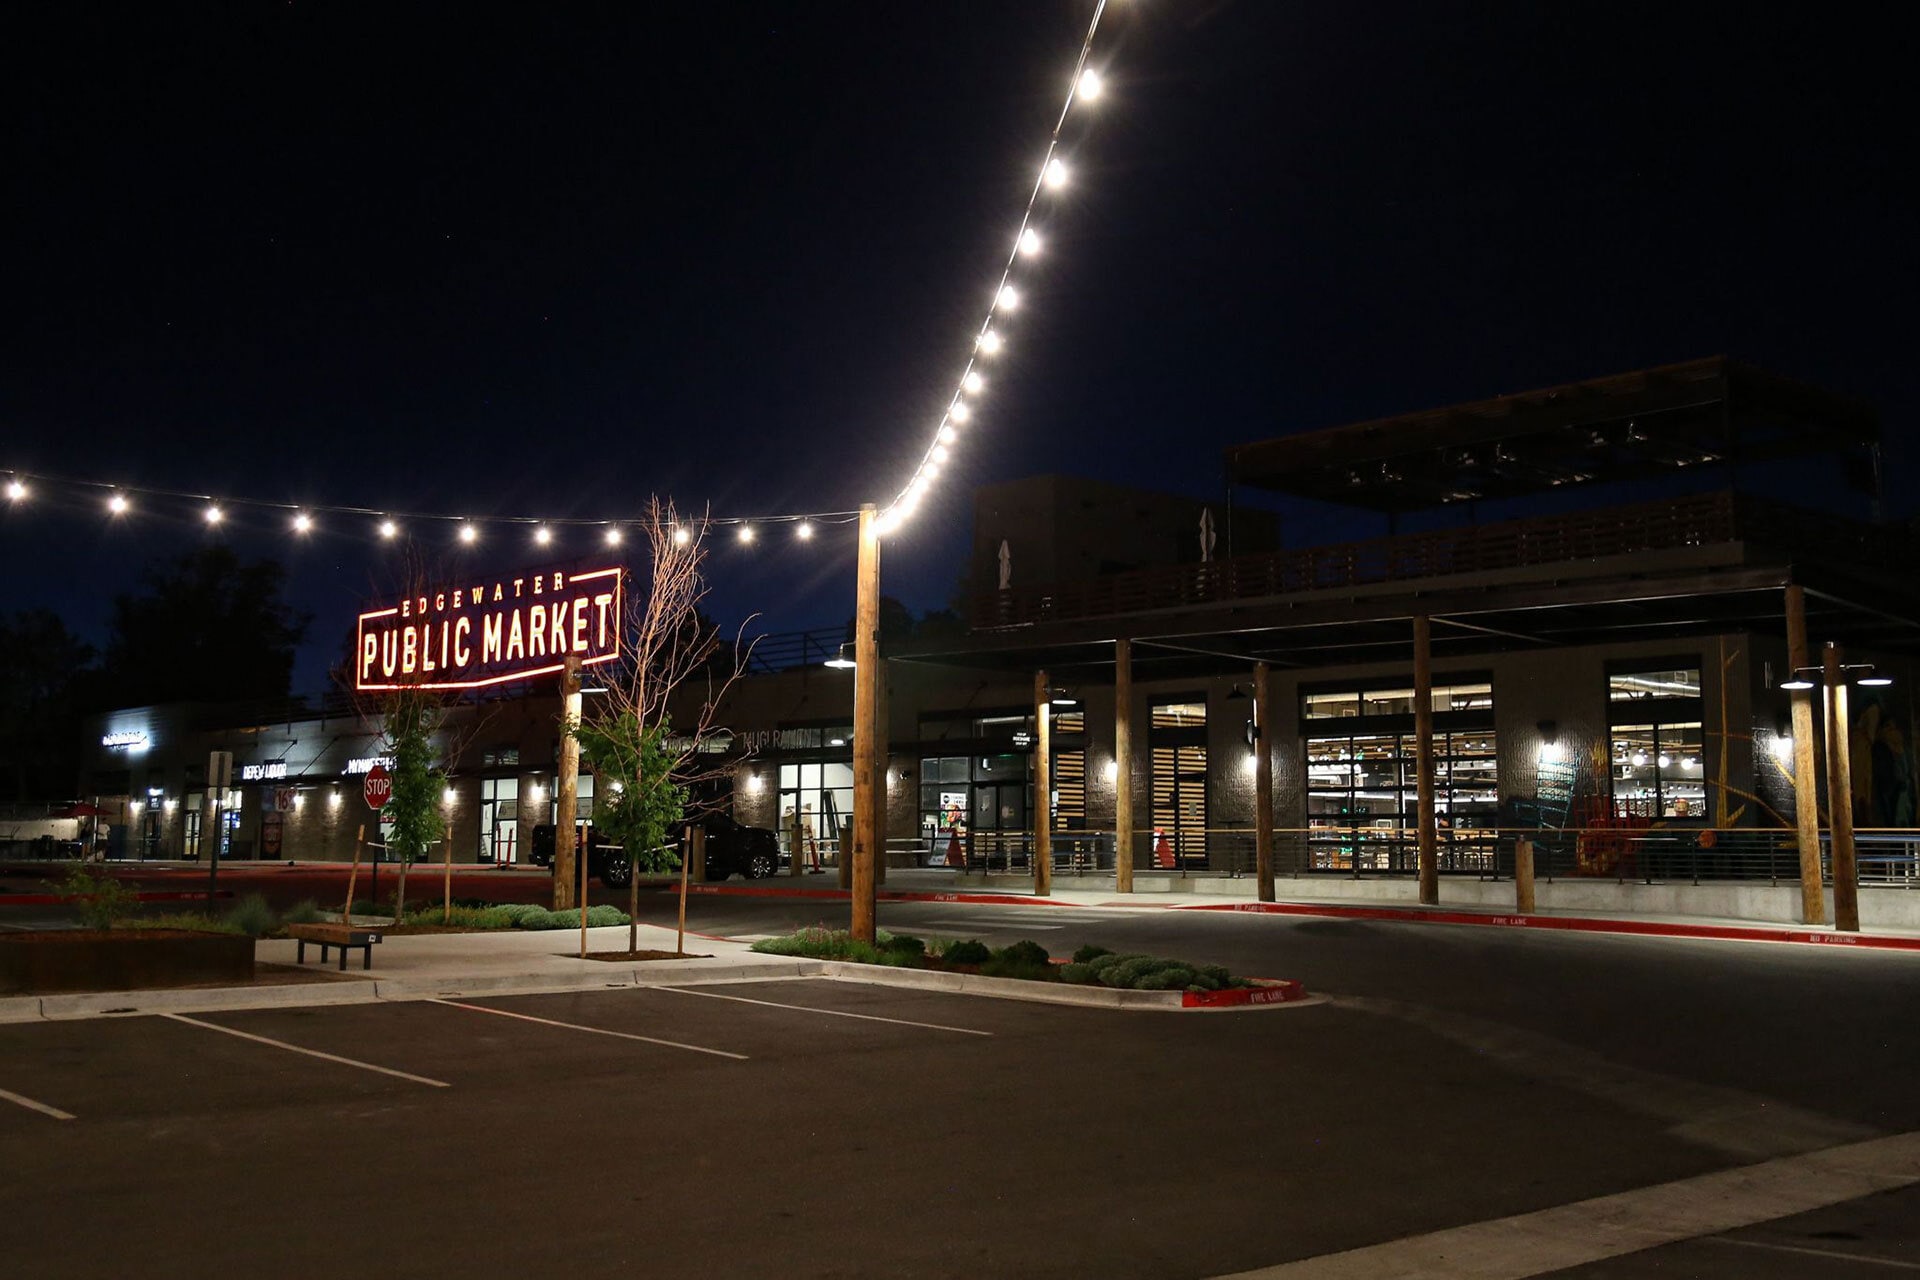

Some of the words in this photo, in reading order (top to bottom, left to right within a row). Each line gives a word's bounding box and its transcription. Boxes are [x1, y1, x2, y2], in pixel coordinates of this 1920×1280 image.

[402, 572, 564, 618] EDGEWATER
[363, 616, 471, 680] PUBLIC
[482, 594, 613, 664] MARKET
[366, 778, 391, 795] STOP
[1809, 934, 1820, 942] NO
[1824, 935, 1857, 944] PARKING
